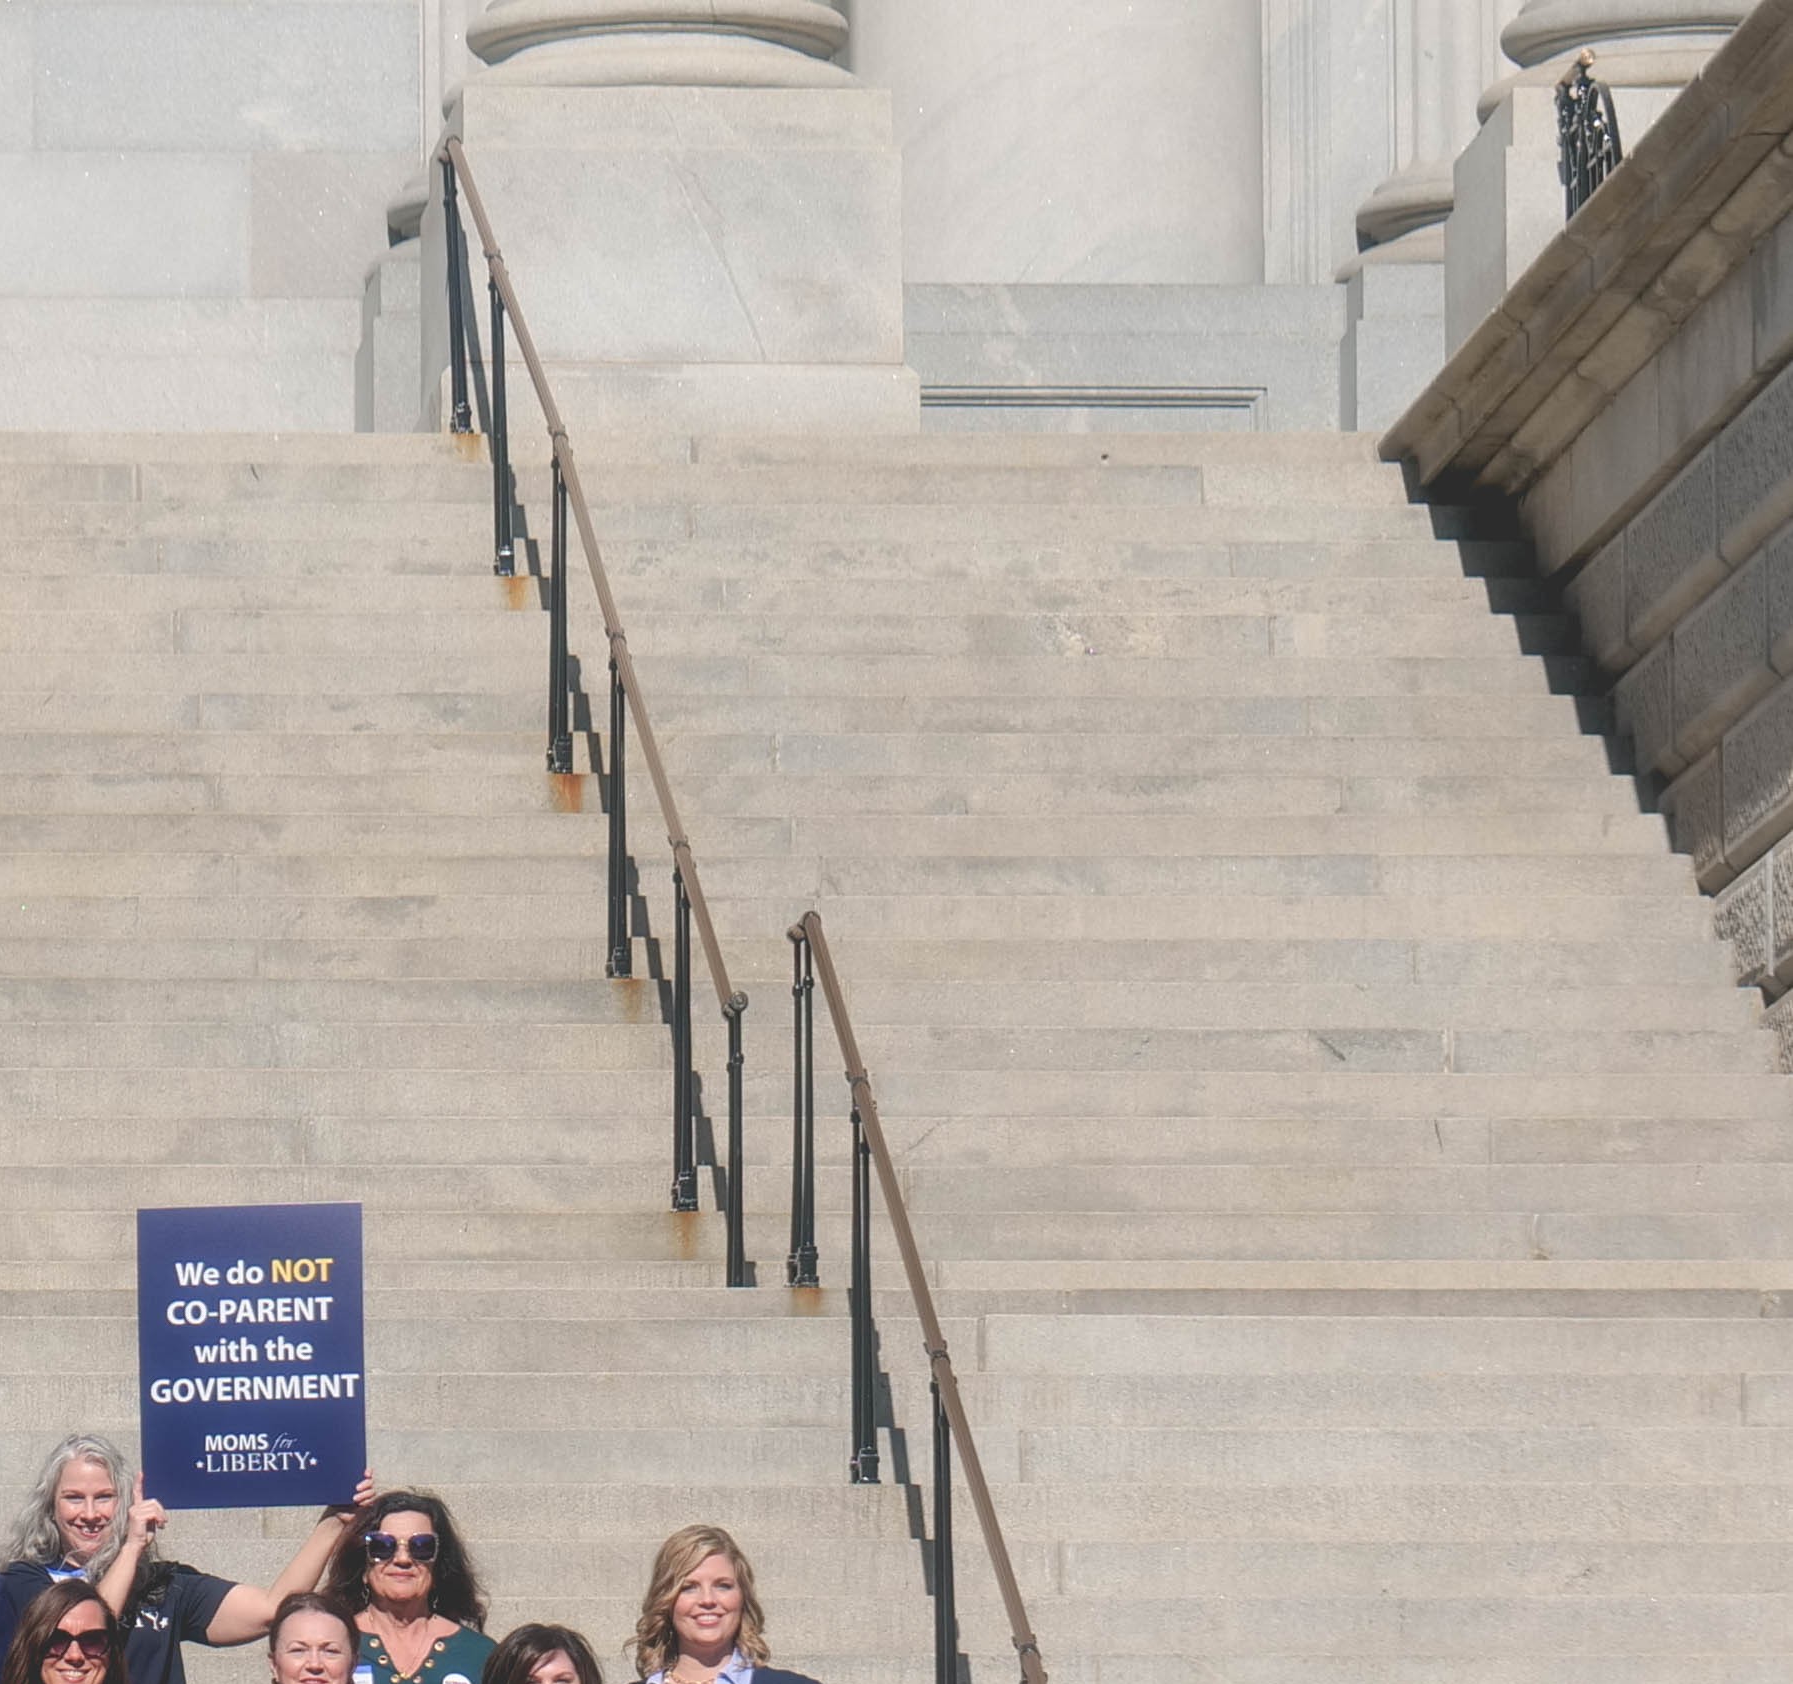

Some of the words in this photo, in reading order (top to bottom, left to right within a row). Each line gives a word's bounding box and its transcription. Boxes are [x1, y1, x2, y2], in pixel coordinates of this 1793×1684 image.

[175, 1262, 220, 1286] We
[226, 1260, 263, 1285] do
[272, 1258, 333, 1283] NOT
[167, 1296, 333, 1325] CO-PARENT
[194, 1337, 258, 1363] with
[265, 1336, 313, 1361] the
[150, 1374, 360, 1403] GOVERNMENT
[205, 1433, 269, 1452] MOMS
[270, 1432, 298, 1452] for
[206, 1451, 310, 1473] LIBERTY
